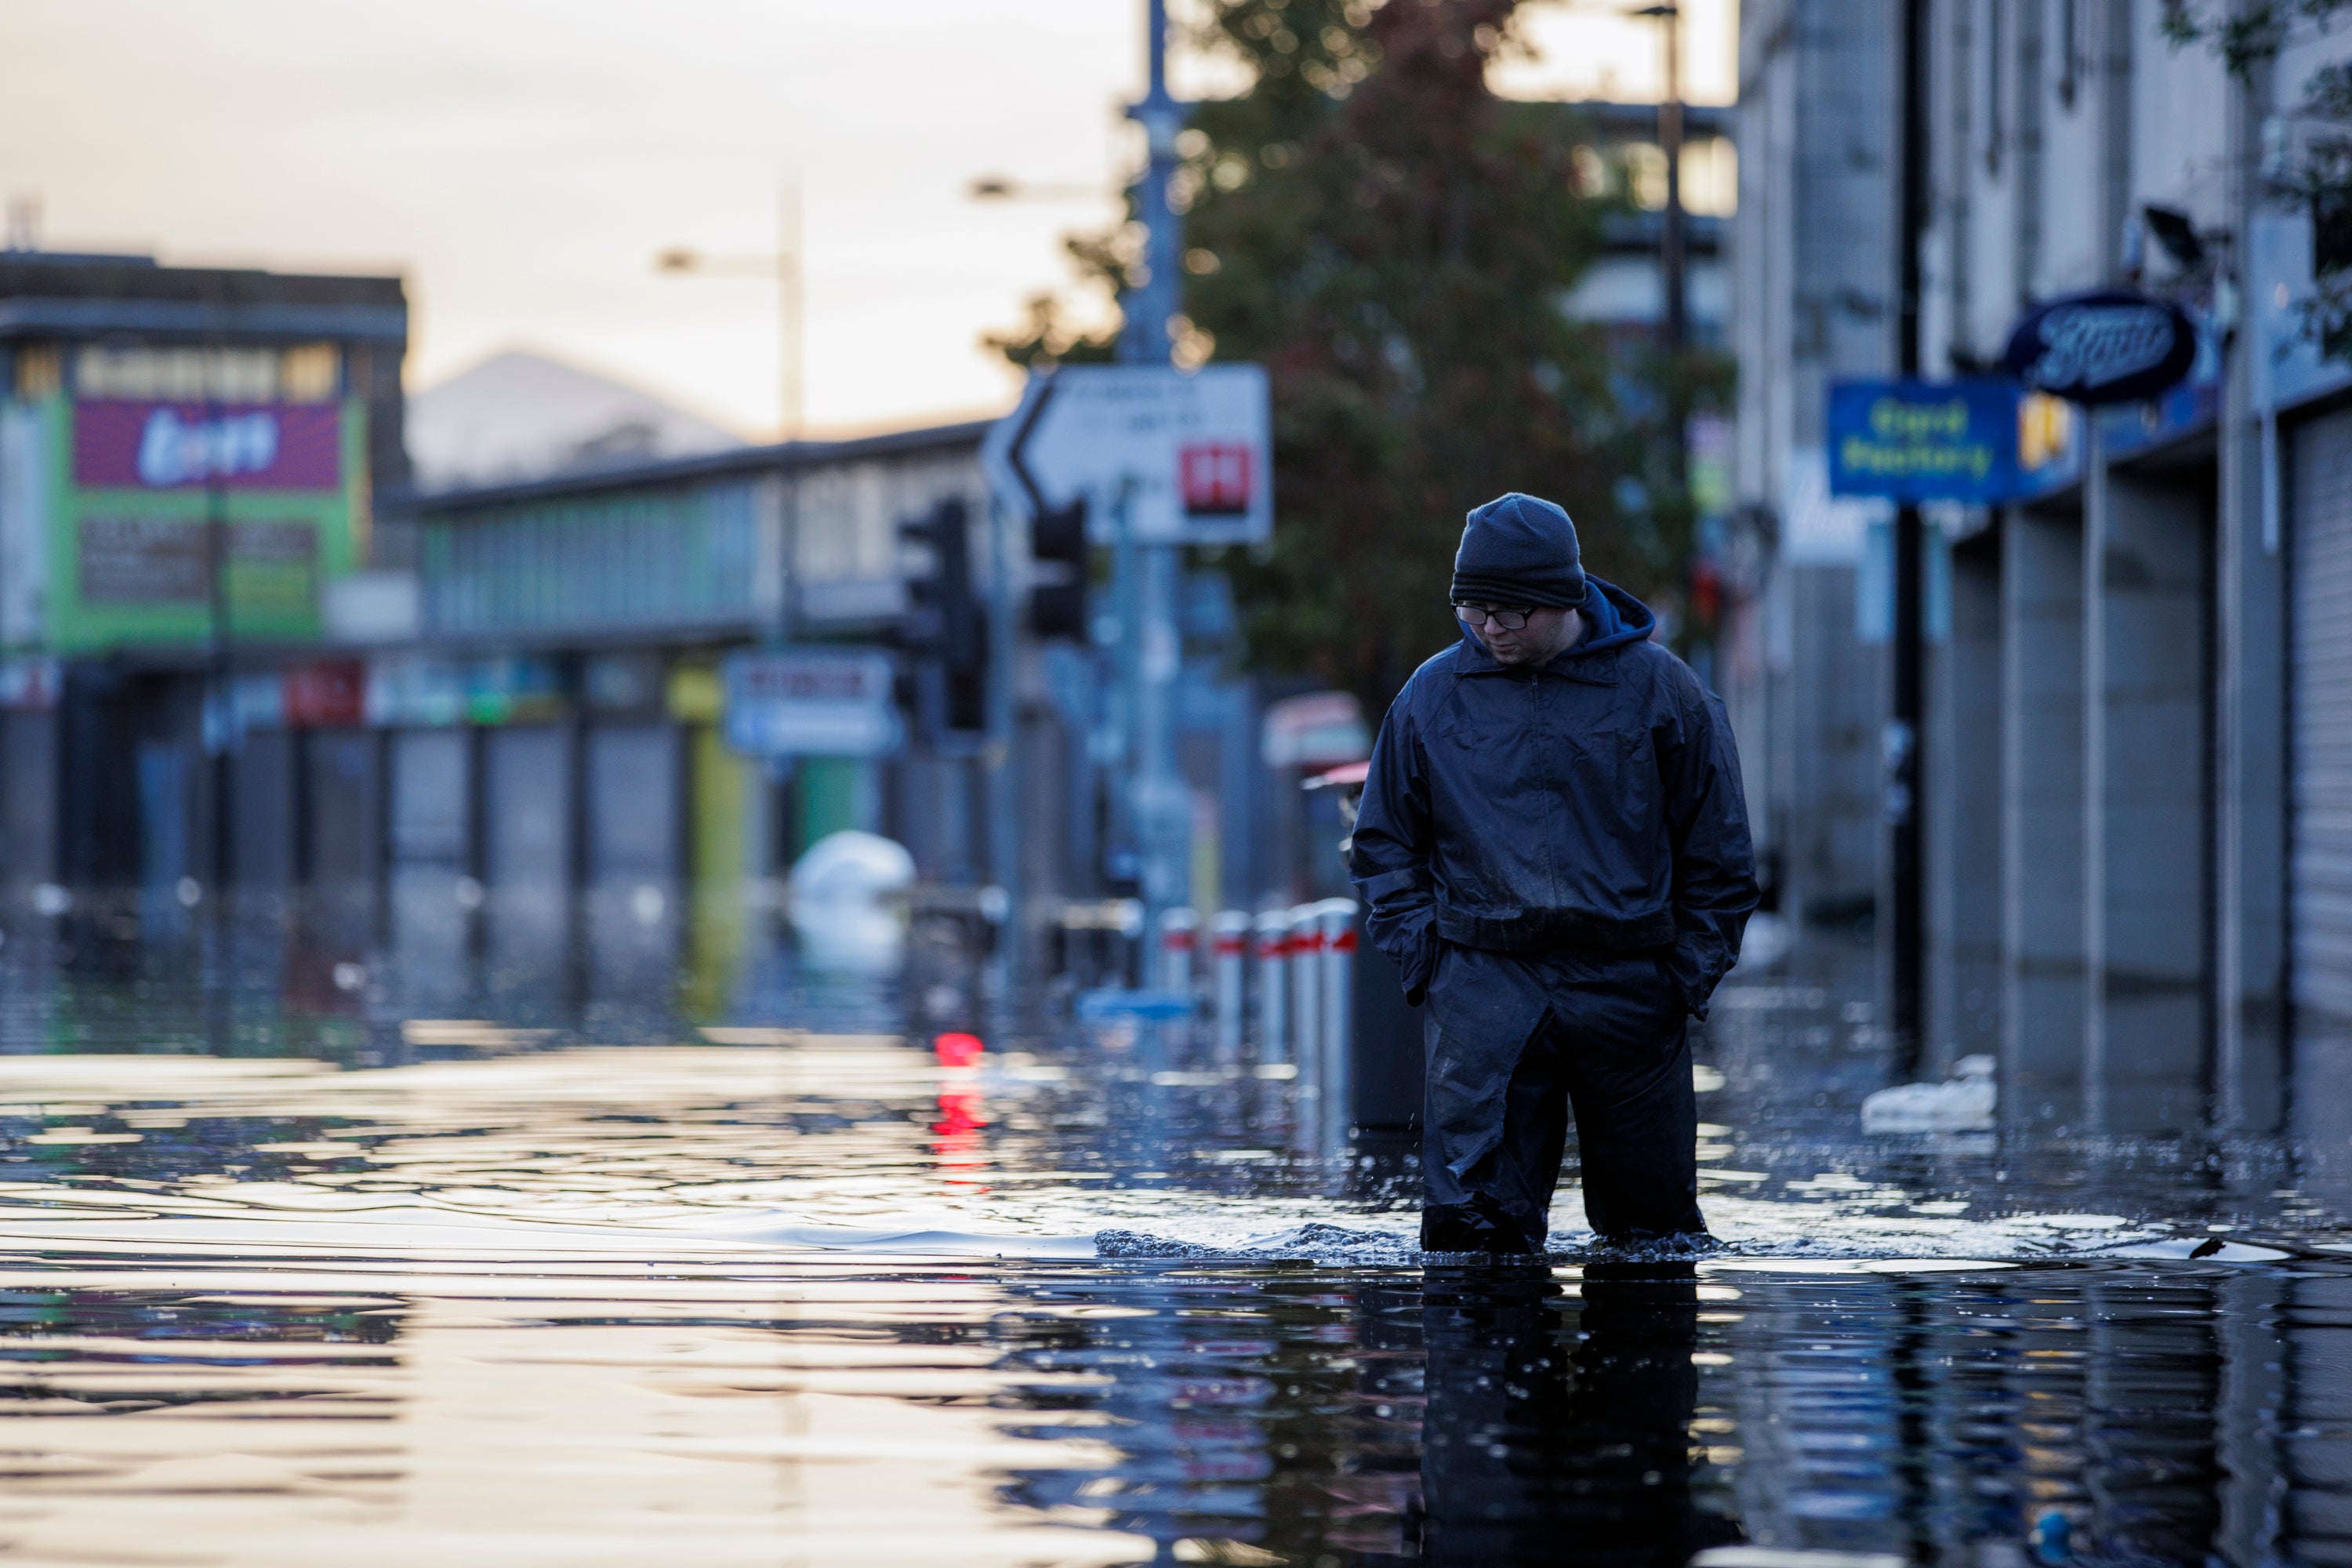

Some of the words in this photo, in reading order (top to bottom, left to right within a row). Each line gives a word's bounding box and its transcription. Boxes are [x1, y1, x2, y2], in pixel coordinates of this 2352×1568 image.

[2031, 307, 2173, 388] Boots
[1871, 398, 1966, 435] Card
[1845, 438, 1992, 481] Factory
